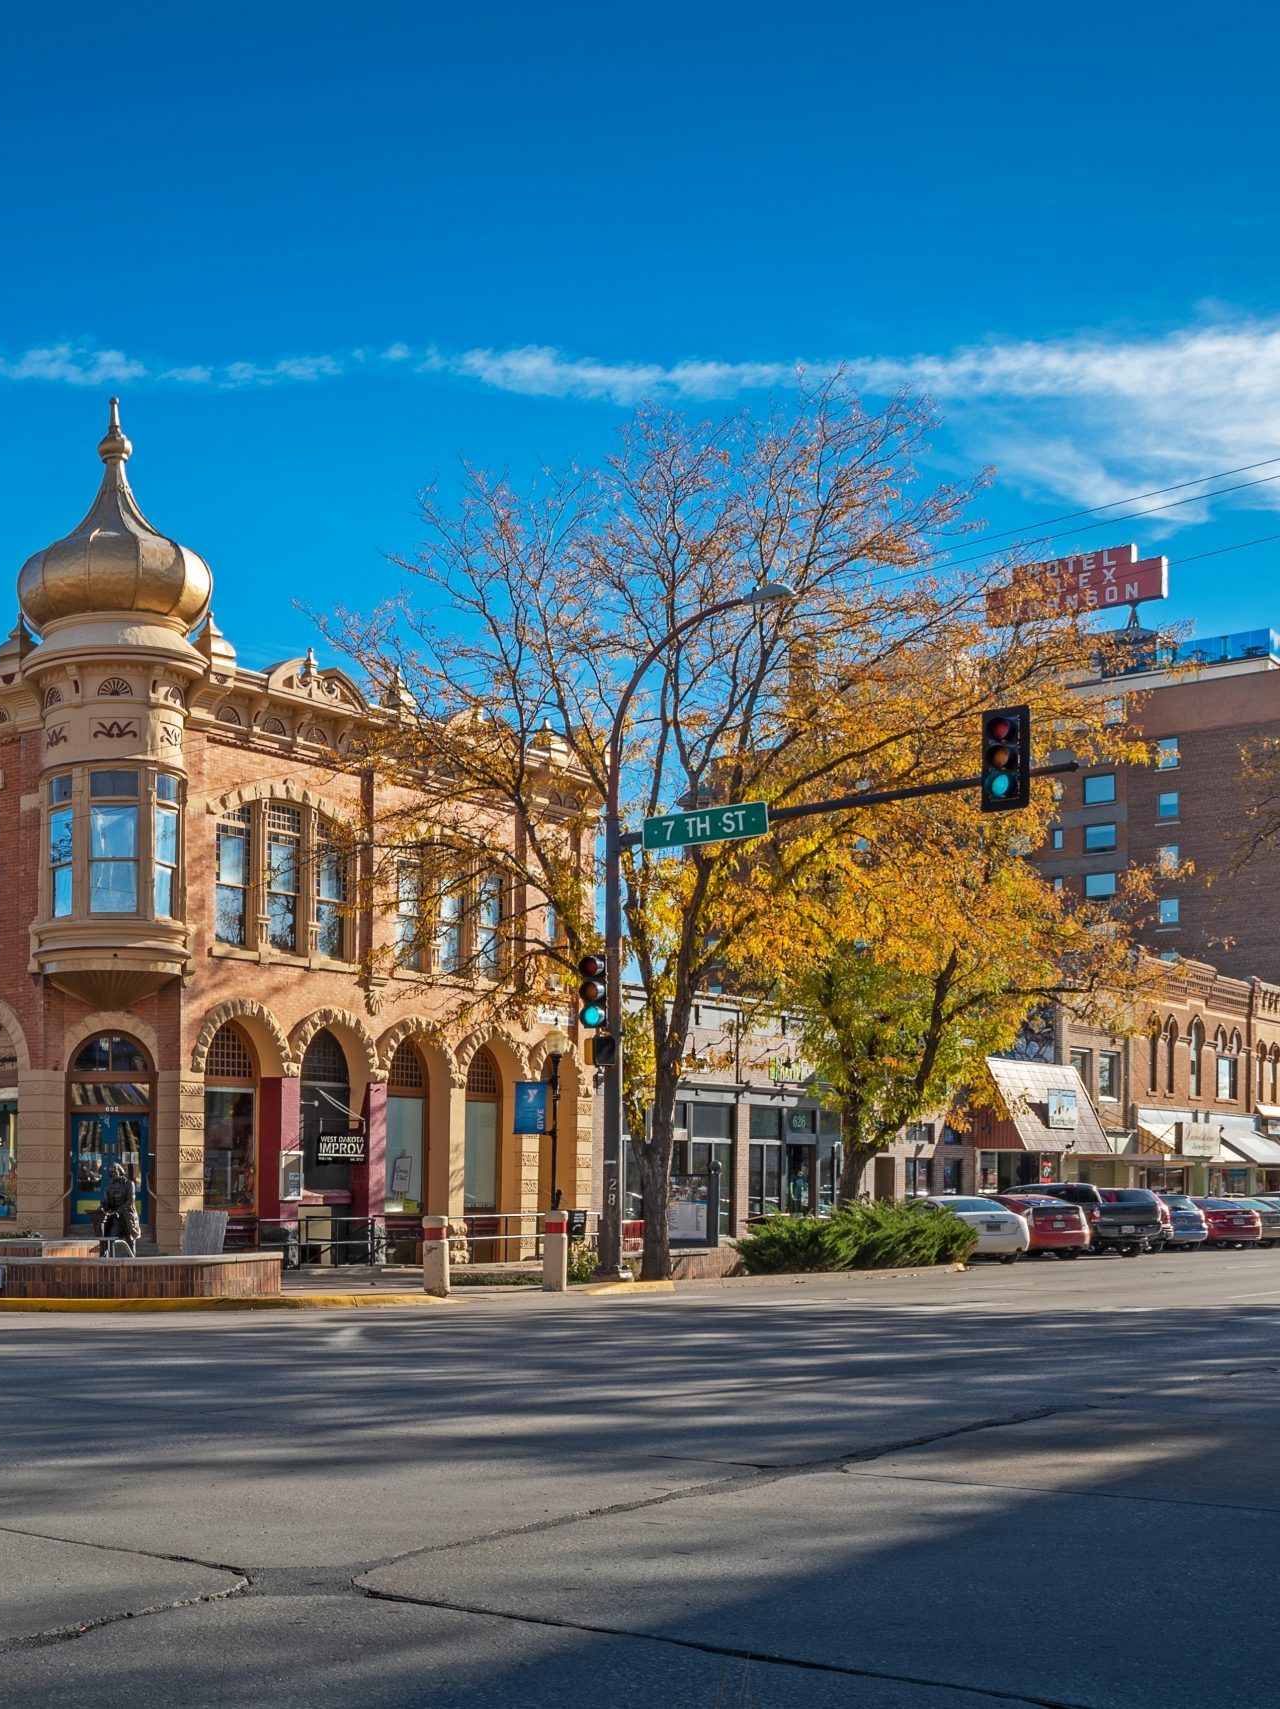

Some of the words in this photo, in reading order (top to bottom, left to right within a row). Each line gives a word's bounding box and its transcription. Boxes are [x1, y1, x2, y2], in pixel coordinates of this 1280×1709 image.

[1054, 567, 1117, 593] LEX
[1026, 581, 1139, 616] HNSON
[662, 820, 675, 841] 7
[684, 815, 711, 838] TH
[722, 810, 746, 833] ST
[792, 1114, 806, 1128] 626
[319, 1142, 364, 1154] IMPROV
